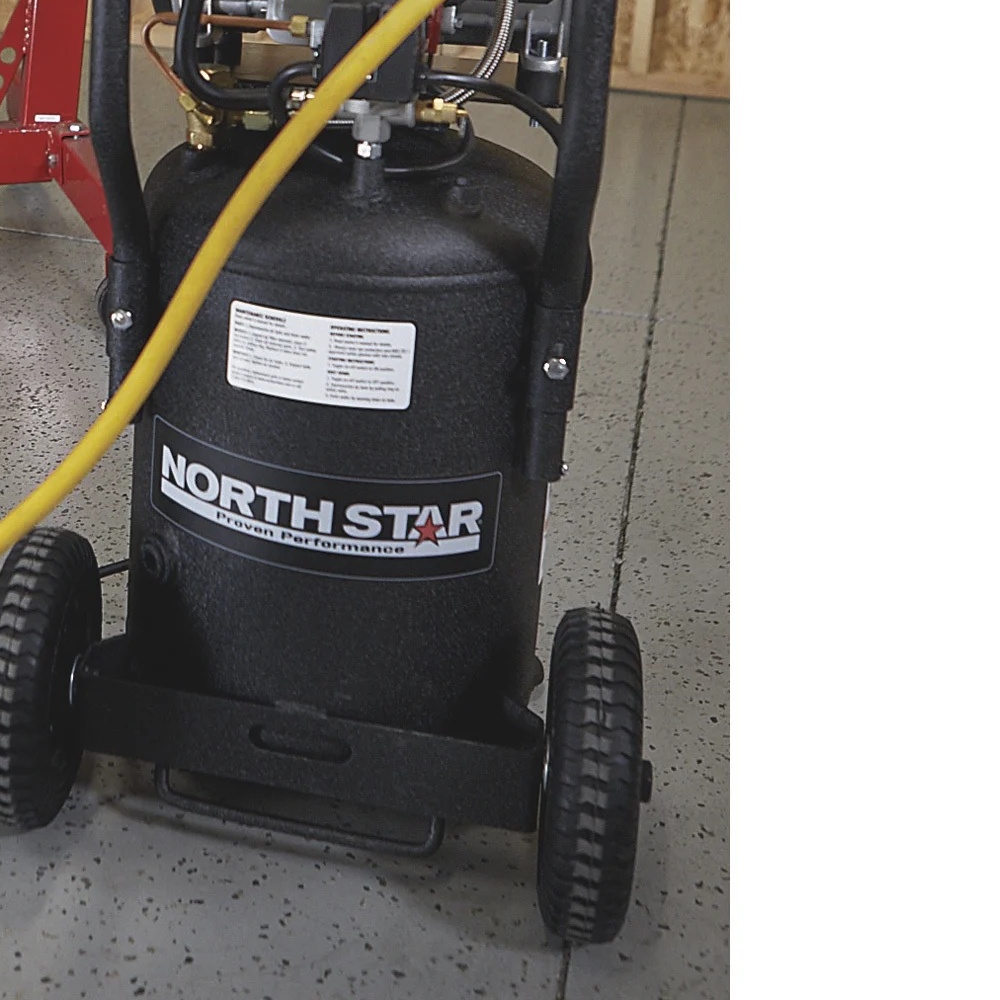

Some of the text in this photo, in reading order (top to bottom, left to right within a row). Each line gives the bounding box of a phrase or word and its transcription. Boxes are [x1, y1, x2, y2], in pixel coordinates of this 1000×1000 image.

[162, 444, 484, 547] NORTH STAR
[216, 511, 406, 555] Proven Performance
